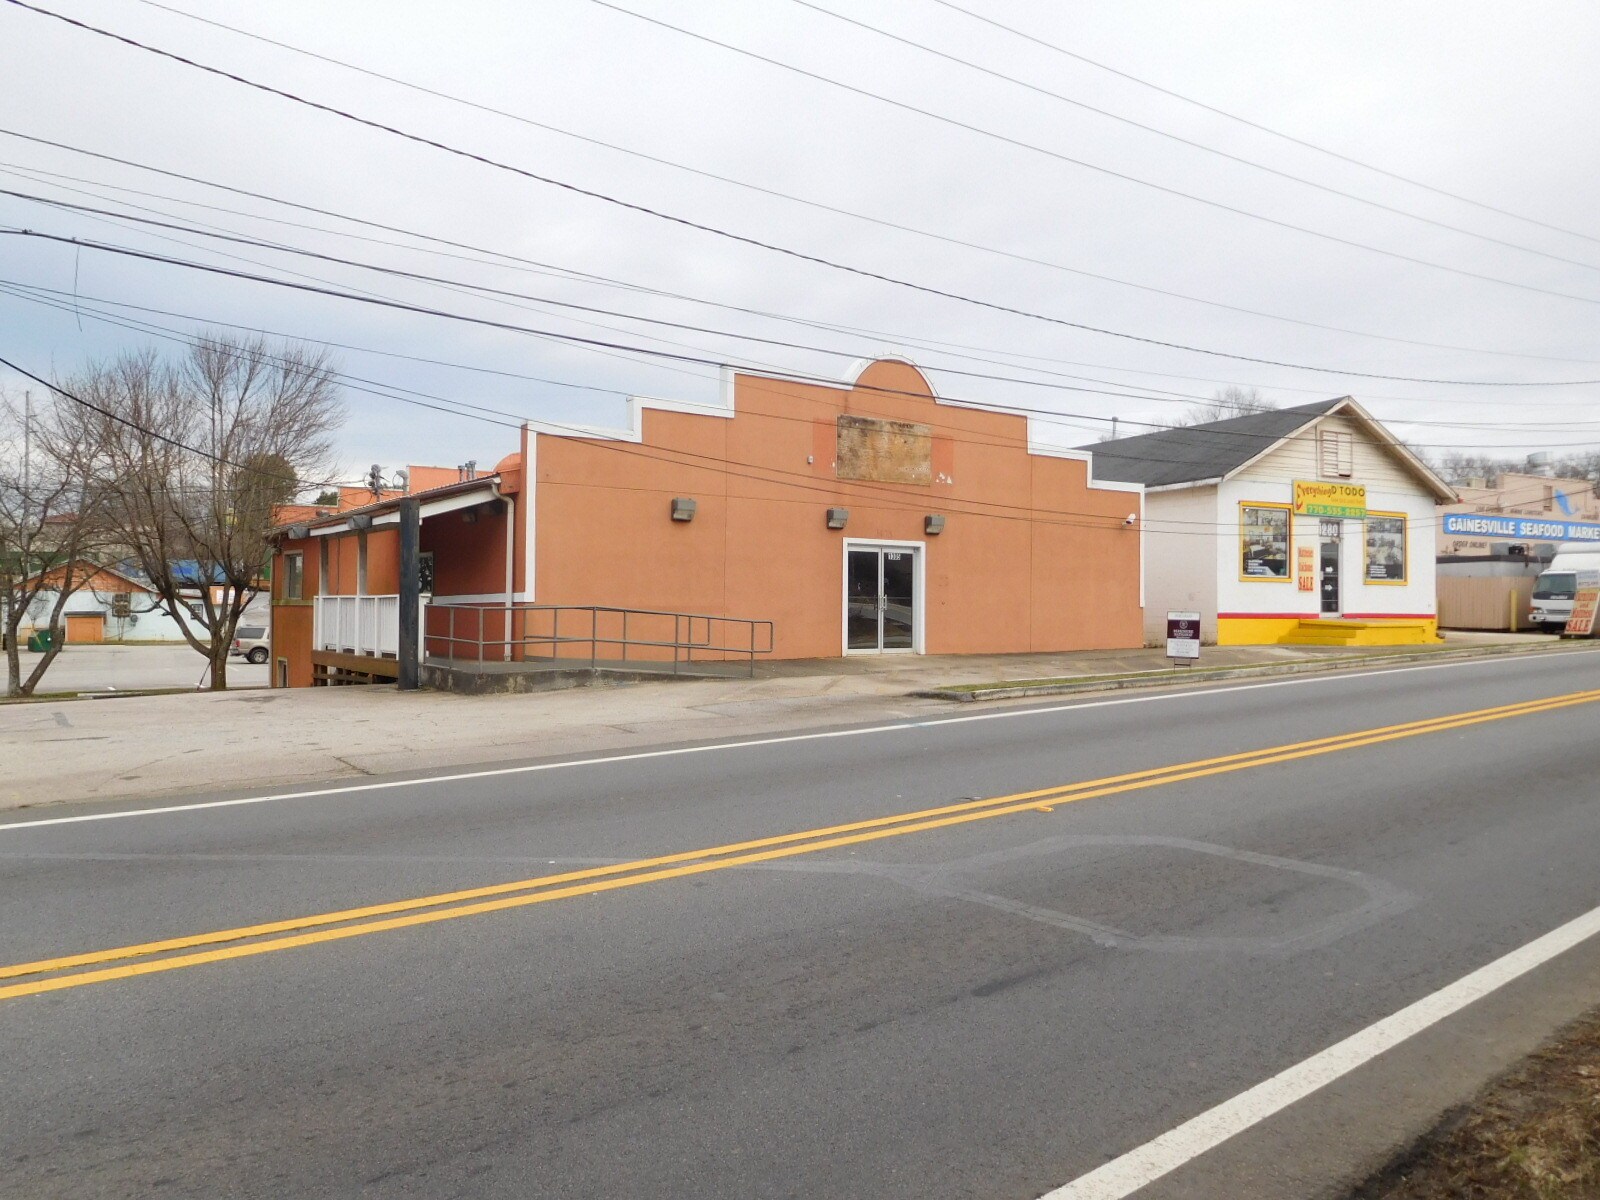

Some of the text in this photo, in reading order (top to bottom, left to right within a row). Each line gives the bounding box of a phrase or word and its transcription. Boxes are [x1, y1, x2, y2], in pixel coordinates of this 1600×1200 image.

[1340, 486, 1365, 497] TODO
[1448, 518, 1516, 534] GAINESVILLE
[1519, 522, 1564, 537] SEAFOOD
